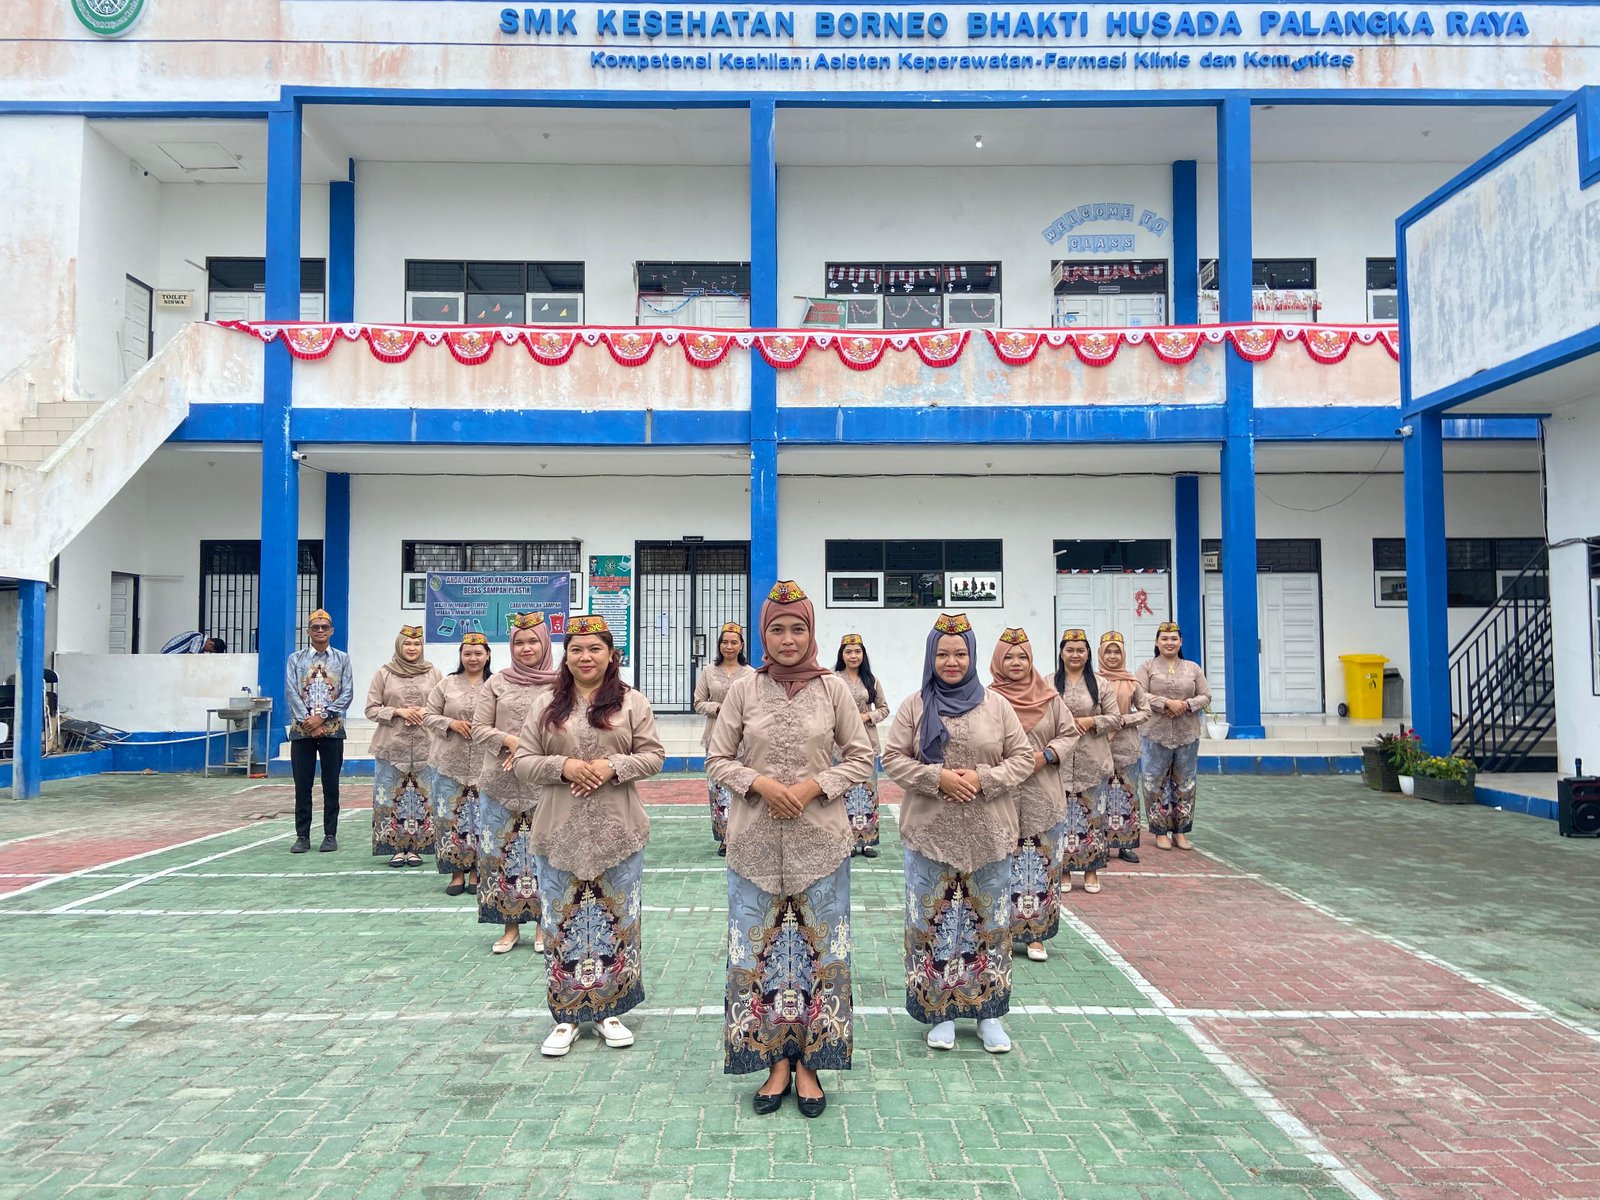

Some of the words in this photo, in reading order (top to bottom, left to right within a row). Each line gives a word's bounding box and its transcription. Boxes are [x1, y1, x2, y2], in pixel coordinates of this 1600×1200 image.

[499, 8, 577, 36] SMK
[597, 9, 794, 37] KESEHATAN
[815, 11, 948, 38] BORNEO
[967, 11, 1088, 38] BHAKTI
[1107, 11, 1242, 37] HUSADA
[1260, 11, 1435, 37] PALANGKA
[1446, 11, 1530, 37] RAYA
[590, 51, 711, 72] Kompetensi
[814, 53, 890, 70] Asisten
[1134, 51, 1191, 69] Klinis
[1200, 51, 1237, 68] dan
[1243, 51, 1354, 71] Komunitas
[1045, 205, 1132, 242] WELCOME
[1142, 212, 1166, 234] TO
[1069, 236, 1133, 250] CLASS
[463, 576, 494, 584] MEMASUKI
[495, 576, 522, 584] KAWASAN
[523, 576, 549, 584] SEKOLAH
[463, 586, 482, 595] BEBAS
[483, 586, 507, 594] SAMPAH
[508, 586, 531, 594] PLASTIK
